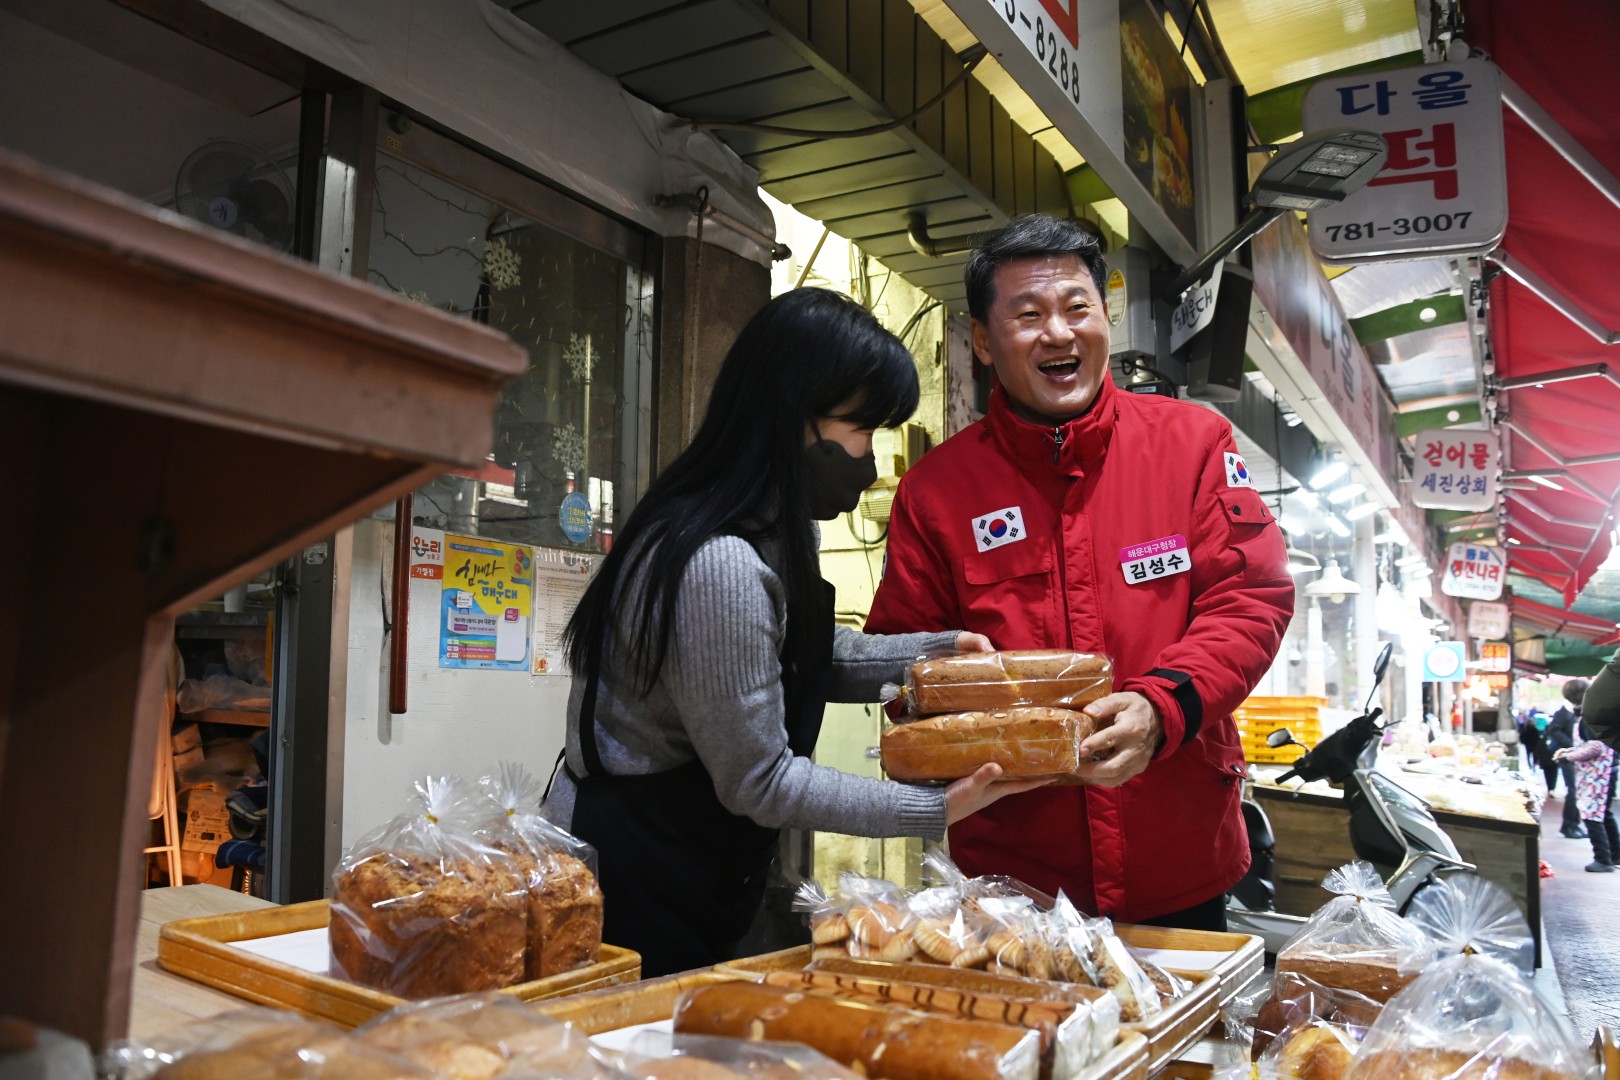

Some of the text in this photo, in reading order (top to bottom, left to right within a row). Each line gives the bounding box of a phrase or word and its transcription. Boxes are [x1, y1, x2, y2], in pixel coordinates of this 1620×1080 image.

[993, 0, 1080, 104] -8288
[1336, 71, 1472, 116] 다올
[1325, 212, 1473, 242] 781-3007
[1423, 440, 1490, 470] 건어물
[1420, 473, 1487, 496] 세진상회
[1127, 539, 1177, 558] 해운대구청장
[1130, 554, 1183, 580] 김성수
[477, 579, 518, 603] 해운대
